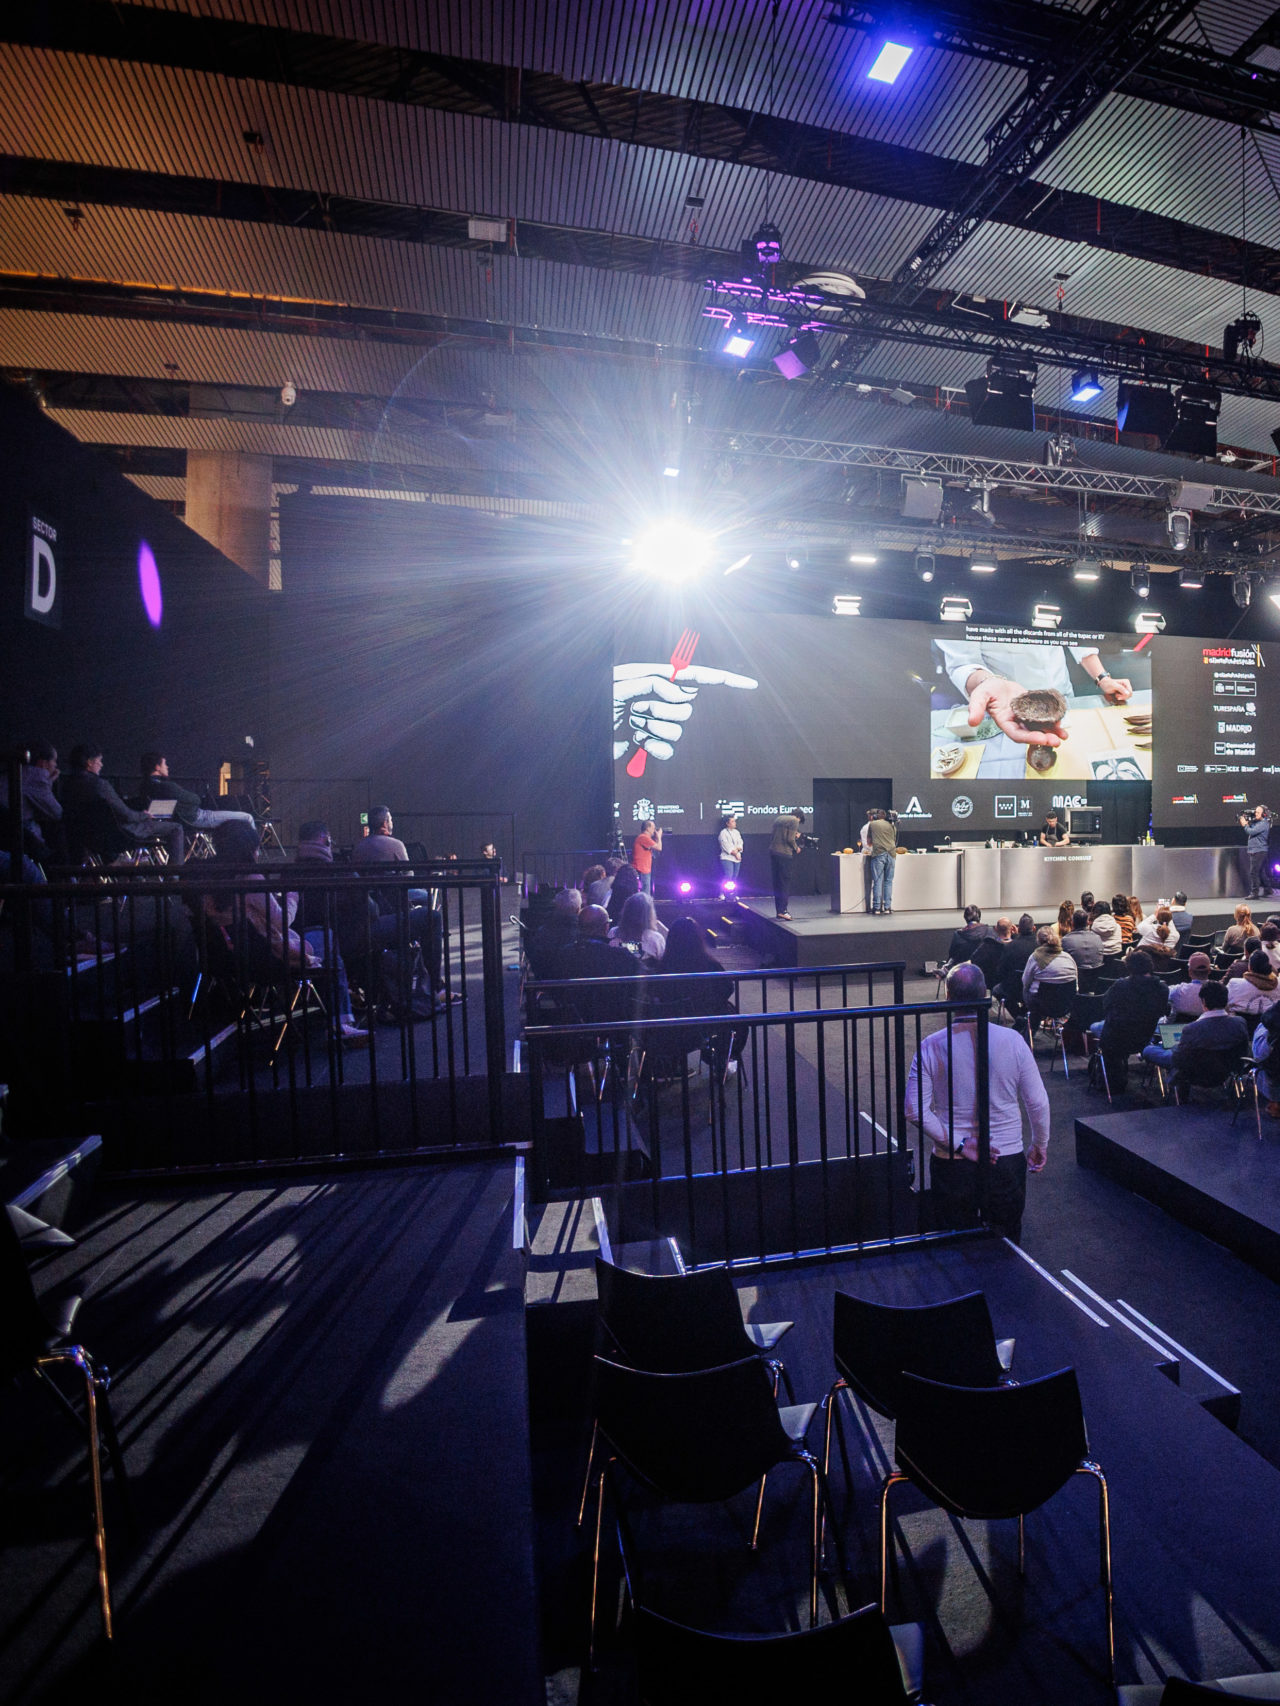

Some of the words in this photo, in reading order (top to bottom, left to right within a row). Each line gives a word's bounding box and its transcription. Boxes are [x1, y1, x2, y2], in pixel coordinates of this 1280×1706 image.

[32, 516, 57, 541] SECTOR
[32, 534, 56, 613] D
[1226, 724, 1252, 734] MADRID
[747, 805, 778, 814] Fondos
[780, 805, 814, 814] Eureo
